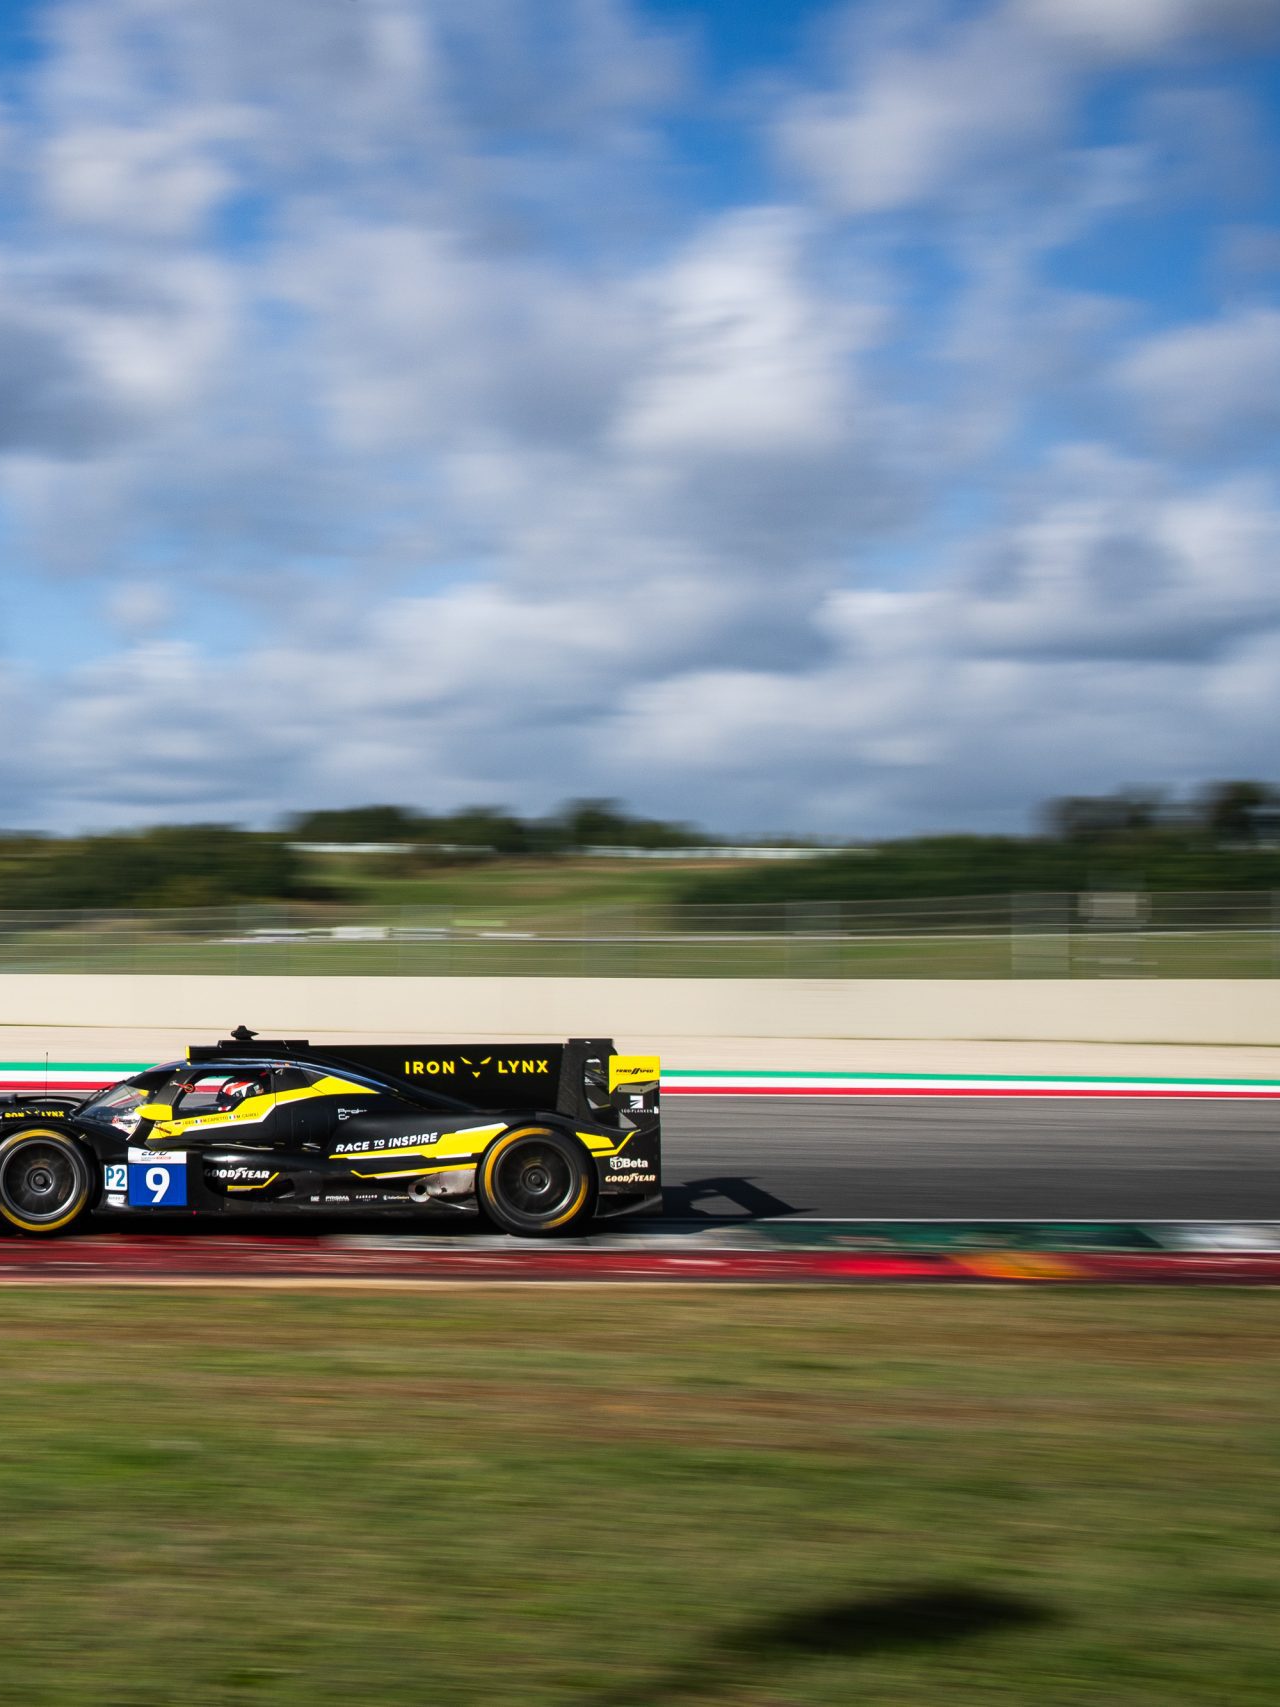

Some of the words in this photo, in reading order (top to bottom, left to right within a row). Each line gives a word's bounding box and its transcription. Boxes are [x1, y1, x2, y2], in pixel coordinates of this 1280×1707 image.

[404, 1060, 455, 1075] IRON
[497, 1060, 549, 1074] LYNX
[335, 1141, 370, 1153] RACE
[373, 1139, 385, 1147] TO
[388, 1132, 438, 1148] INSPIRE
[105, 1167, 125, 1187] P2
[204, 1167, 270, 1180] GOODYEAR
[605, 1172, 656, 1183] GOODYEAR
[145, 1166, 170, 1203] 9
